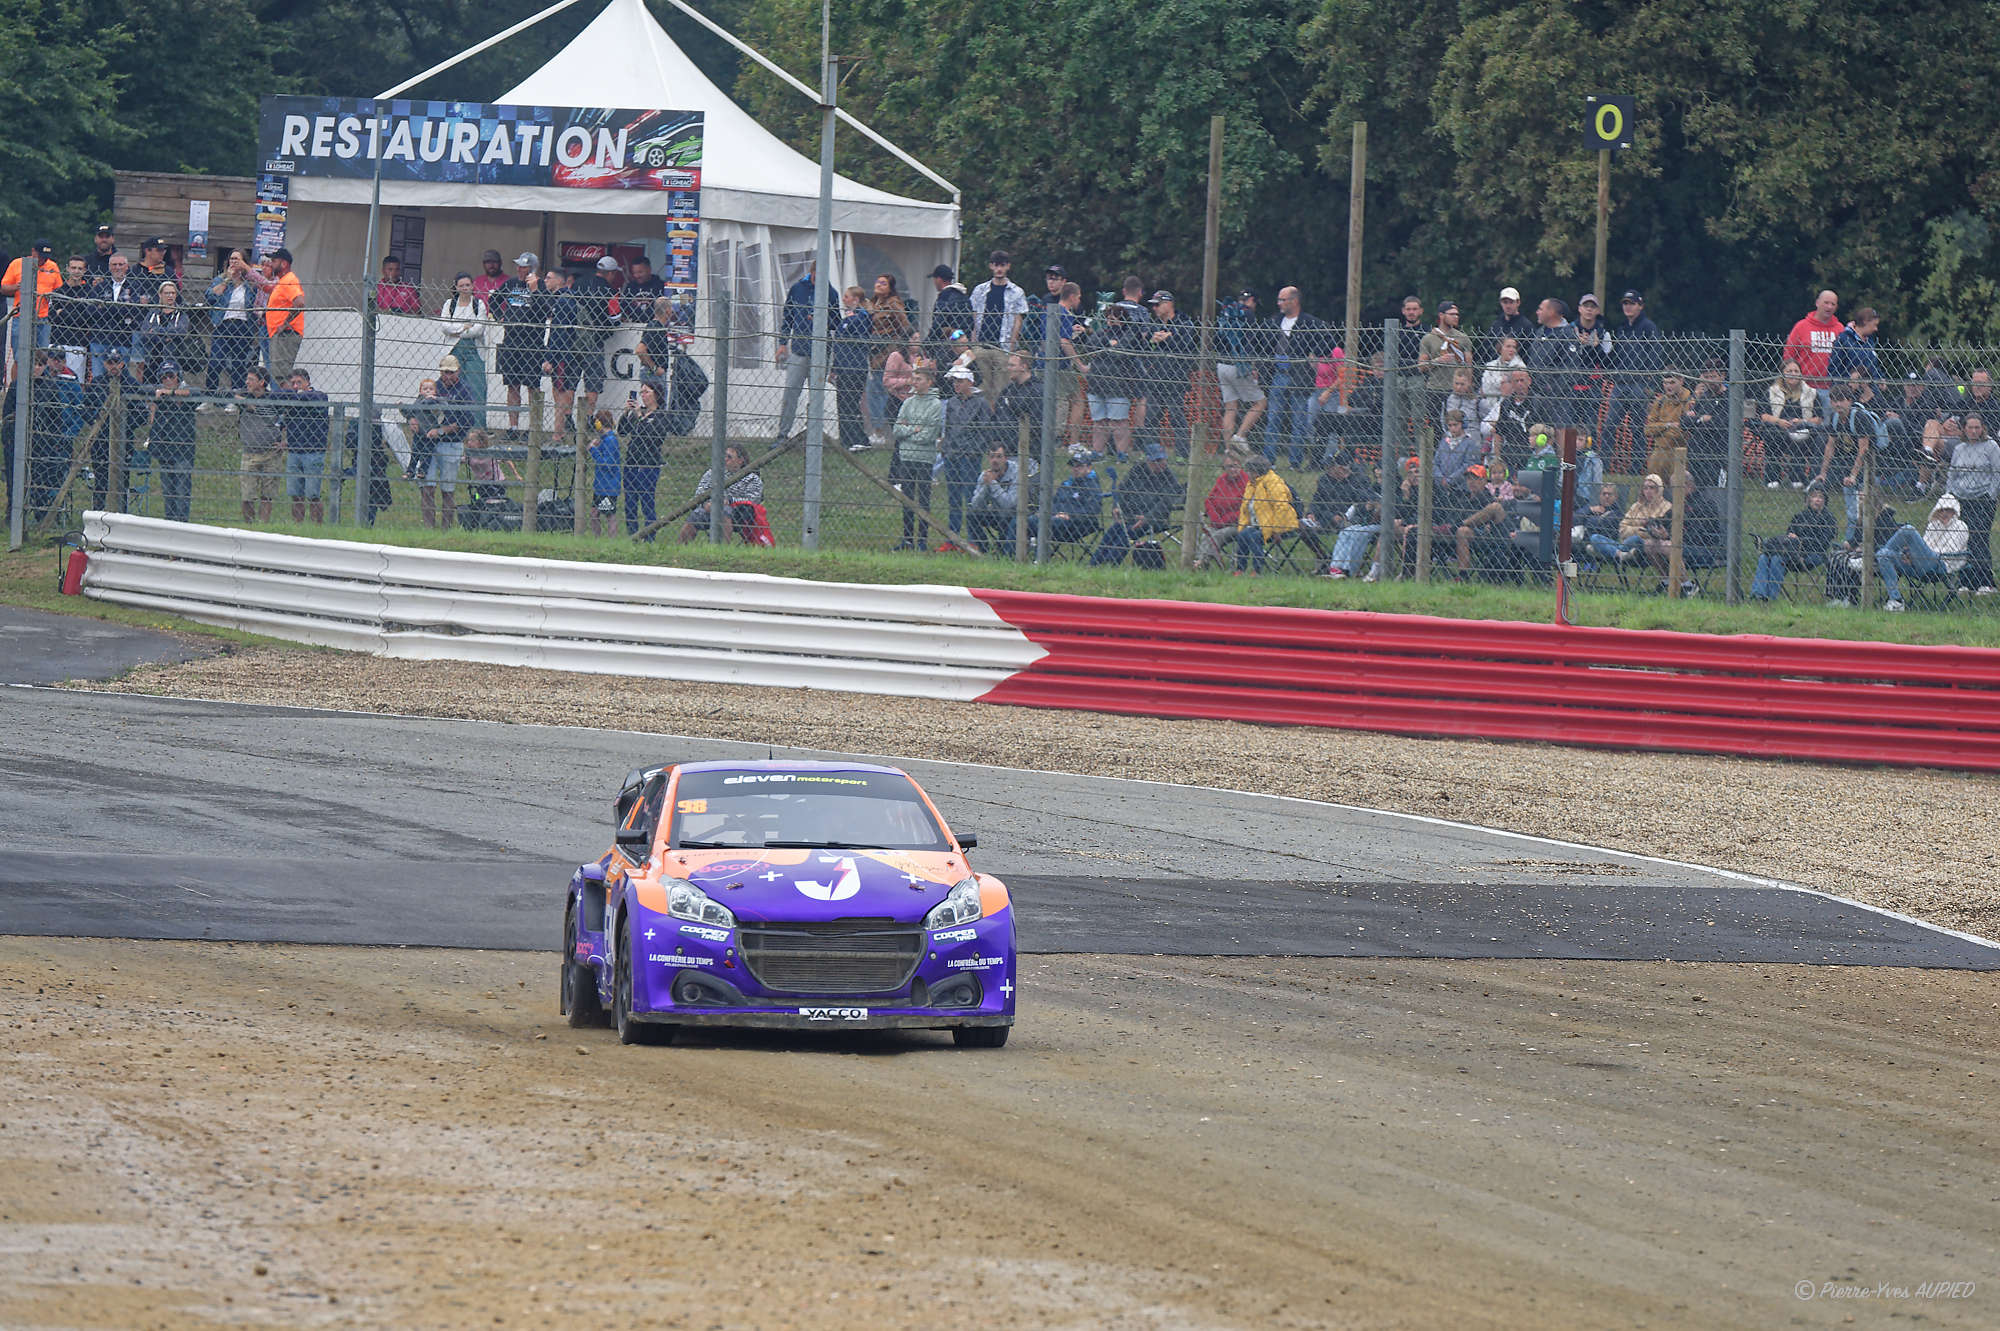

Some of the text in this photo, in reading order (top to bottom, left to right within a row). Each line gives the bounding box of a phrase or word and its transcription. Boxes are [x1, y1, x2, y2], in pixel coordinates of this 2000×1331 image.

[280, 115, 628, 169] RESTAURATION
[723, 774, 868, 786] eleven motorsport
[677, 799, 708, 814] 98
[680, 925, 730, 938] COOPER
[933, 928, 977, 941] COOPER
[808, 1009, 862, 1019] YACCO
